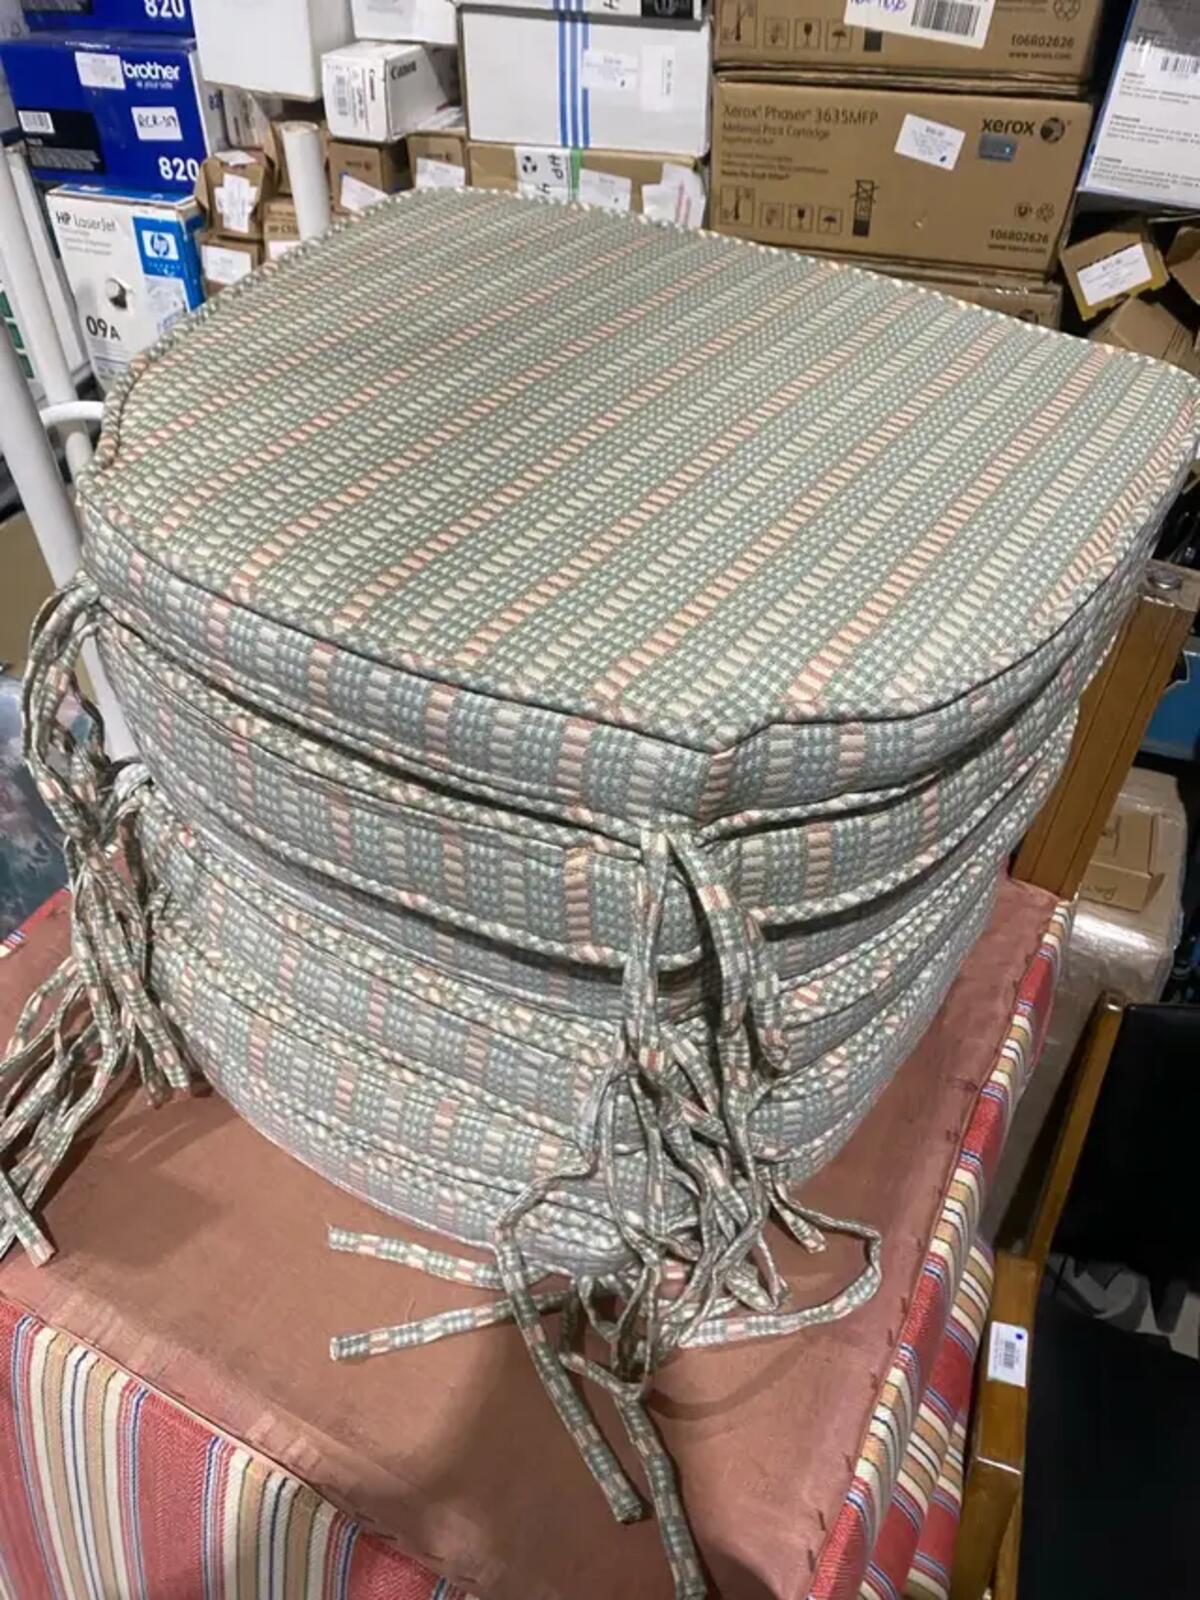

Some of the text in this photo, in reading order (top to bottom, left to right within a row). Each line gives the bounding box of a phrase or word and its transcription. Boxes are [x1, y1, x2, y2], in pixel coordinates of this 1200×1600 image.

[145, 0, 185, 17] 820
[122, 60, 180, 80] brother
[390, 61, 417, 80] Canon
[814, 107, 879, 127] 3635MFP
[980, 118, 1036, 136] xerox
[158, 156, 199, 181] 820
[73, 214, 117, 232] LaserJet
[86, 315, 121, 341] 09A
